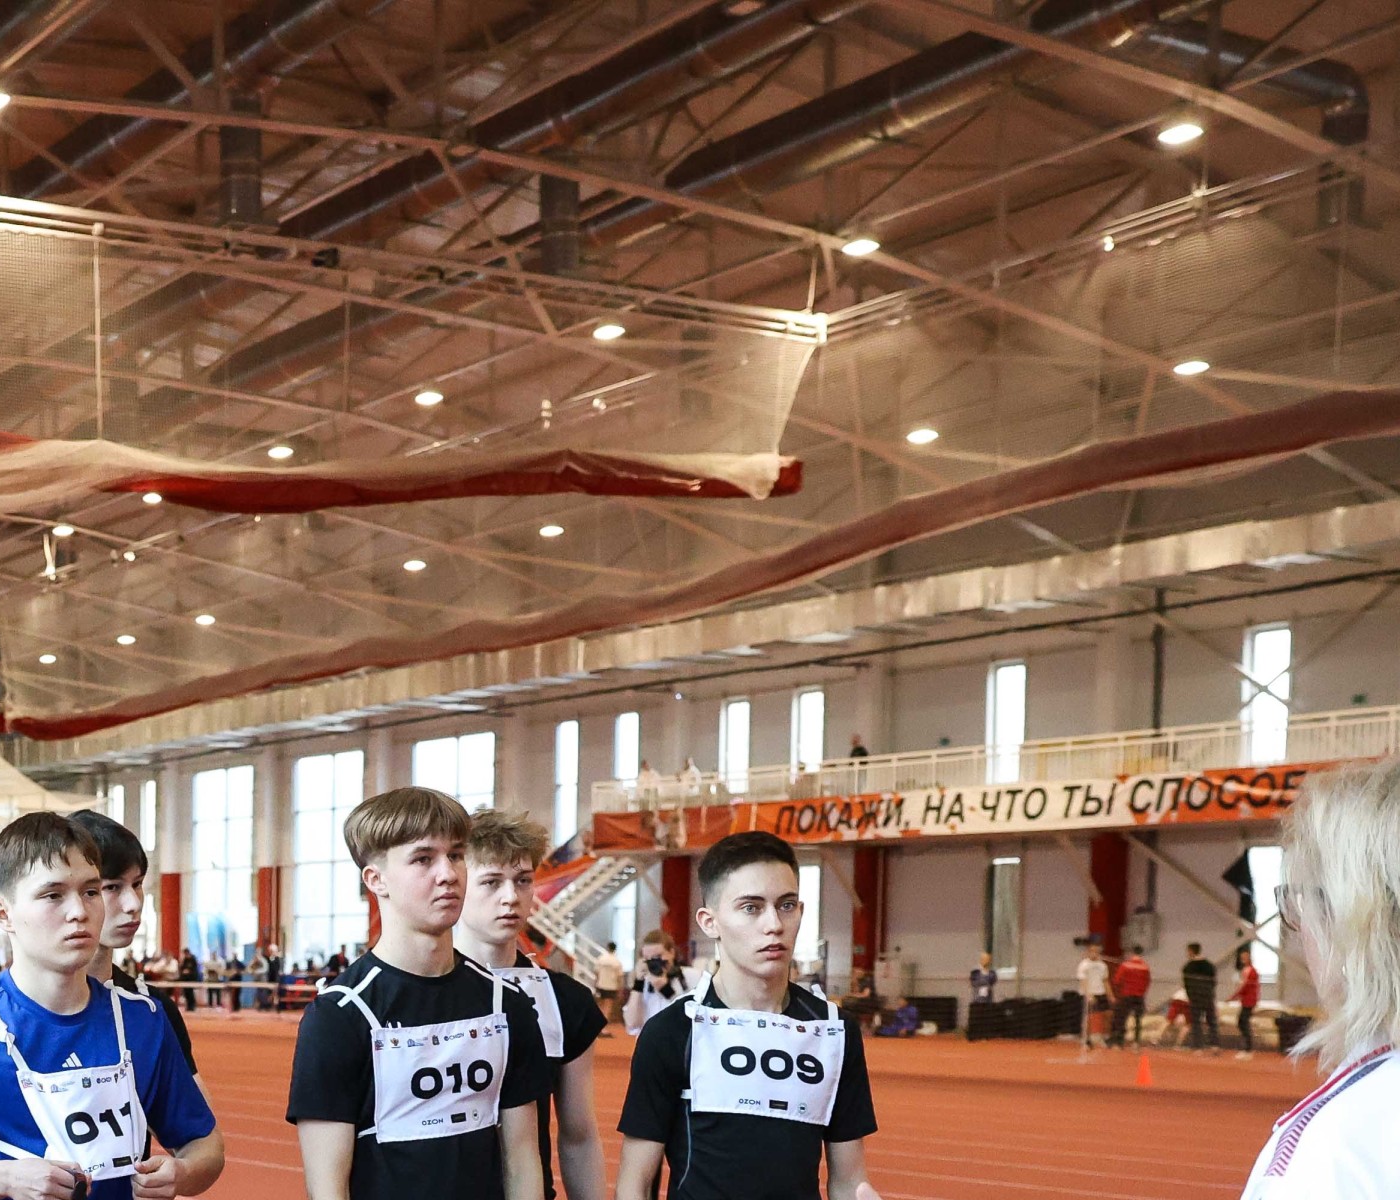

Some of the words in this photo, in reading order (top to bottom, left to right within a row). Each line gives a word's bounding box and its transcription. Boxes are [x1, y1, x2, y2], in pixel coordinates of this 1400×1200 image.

[774, 797, 911, 836] ПОКАЖИ,
[922, 793, 965, 825] НА
[981, 787, 1048, 821] ЧТО
[1063, 783, 1118, 819] ТЫ
[410, 1059, 494, 1100] 010
[720, 1045, 825, 1085] 009
[421, 1117, 444, 1126] OZON
